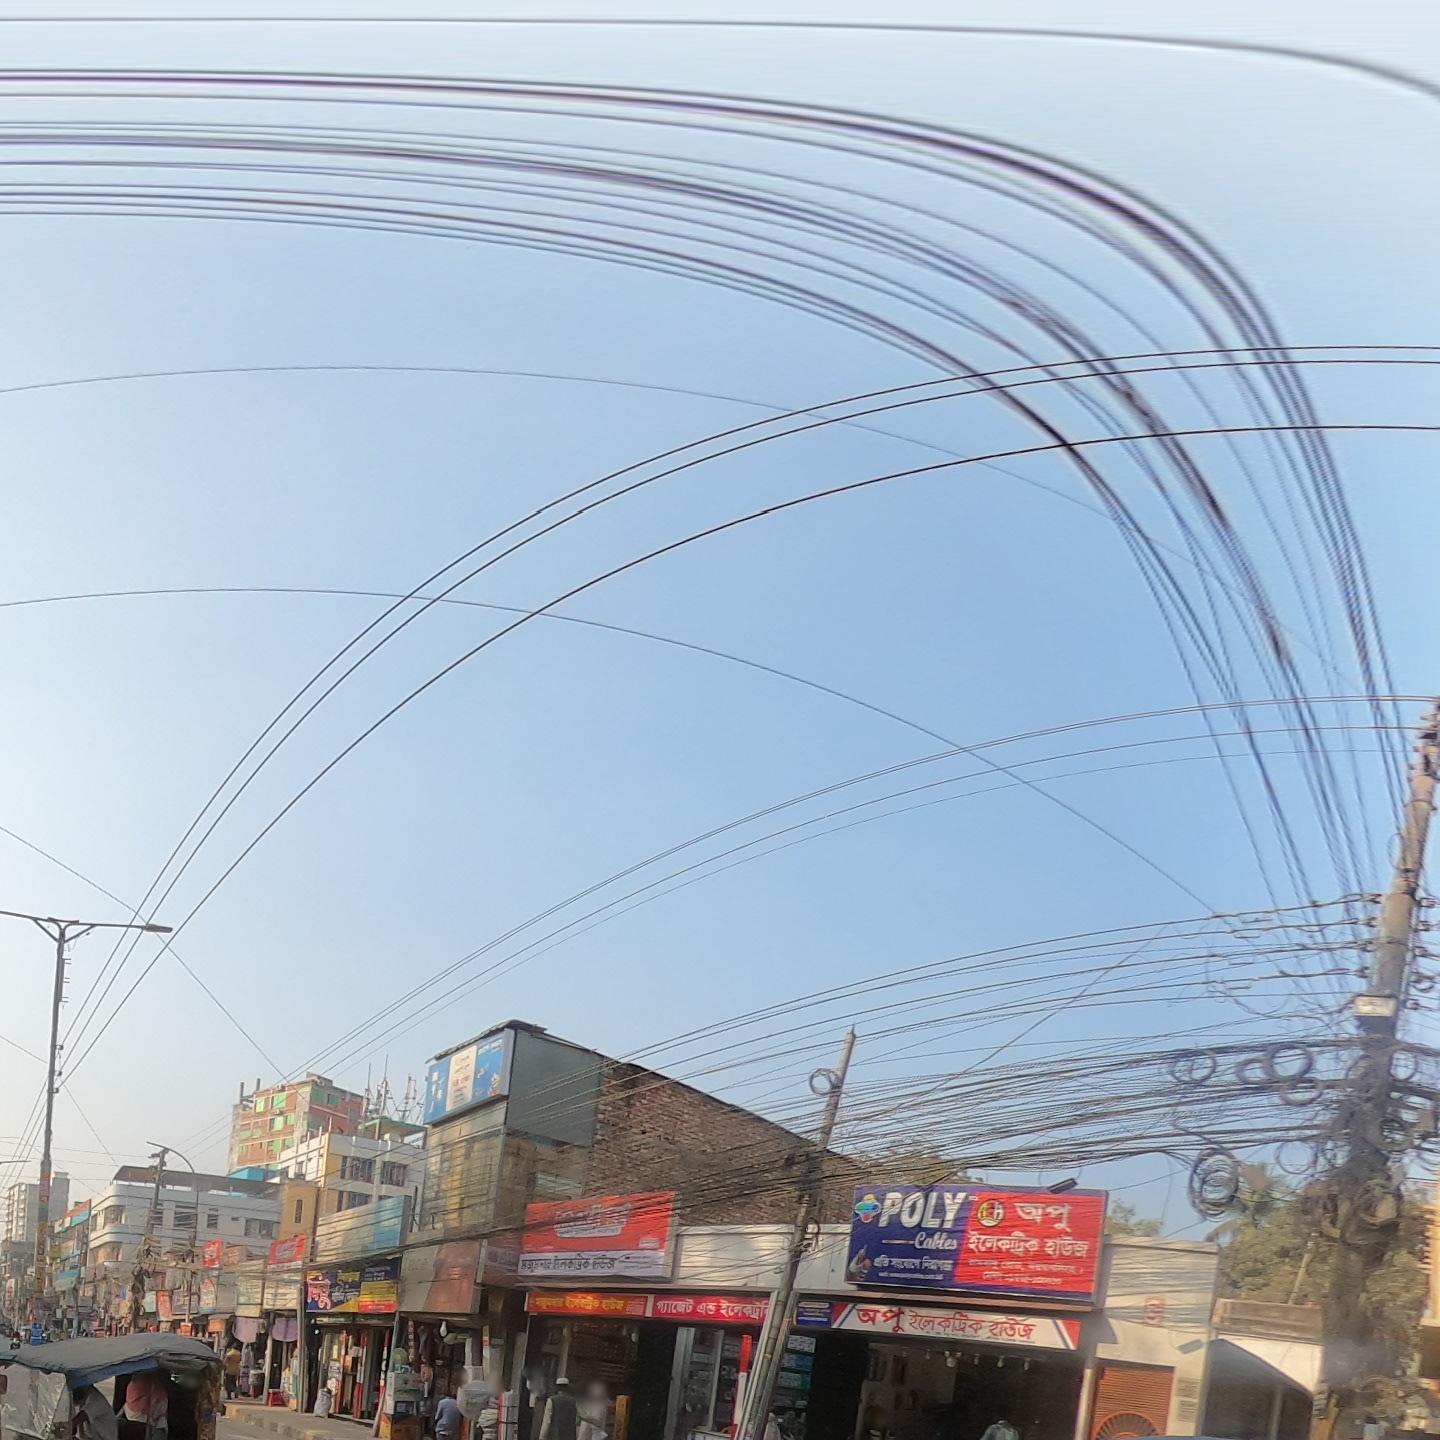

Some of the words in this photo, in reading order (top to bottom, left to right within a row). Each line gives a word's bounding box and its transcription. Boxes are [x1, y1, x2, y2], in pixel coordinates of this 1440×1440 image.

[878, 1191, 967, 1229] POLY
[1015, 1202, 1072, 1232] অপু
[914, 1231, 958, 1250] Cables
[1044, 1237, 1090, 1258] হাউজ
[656, 1298, 693, 1314] গ্যাজেট
[697, 1301, 717, 1315] এন্ড
[856, 1307, 905, 1333] অপু
[909, 1311, 983, 1335] ইলেকট্রিক
[989, 1316, 1036, 1340] হাউজ
